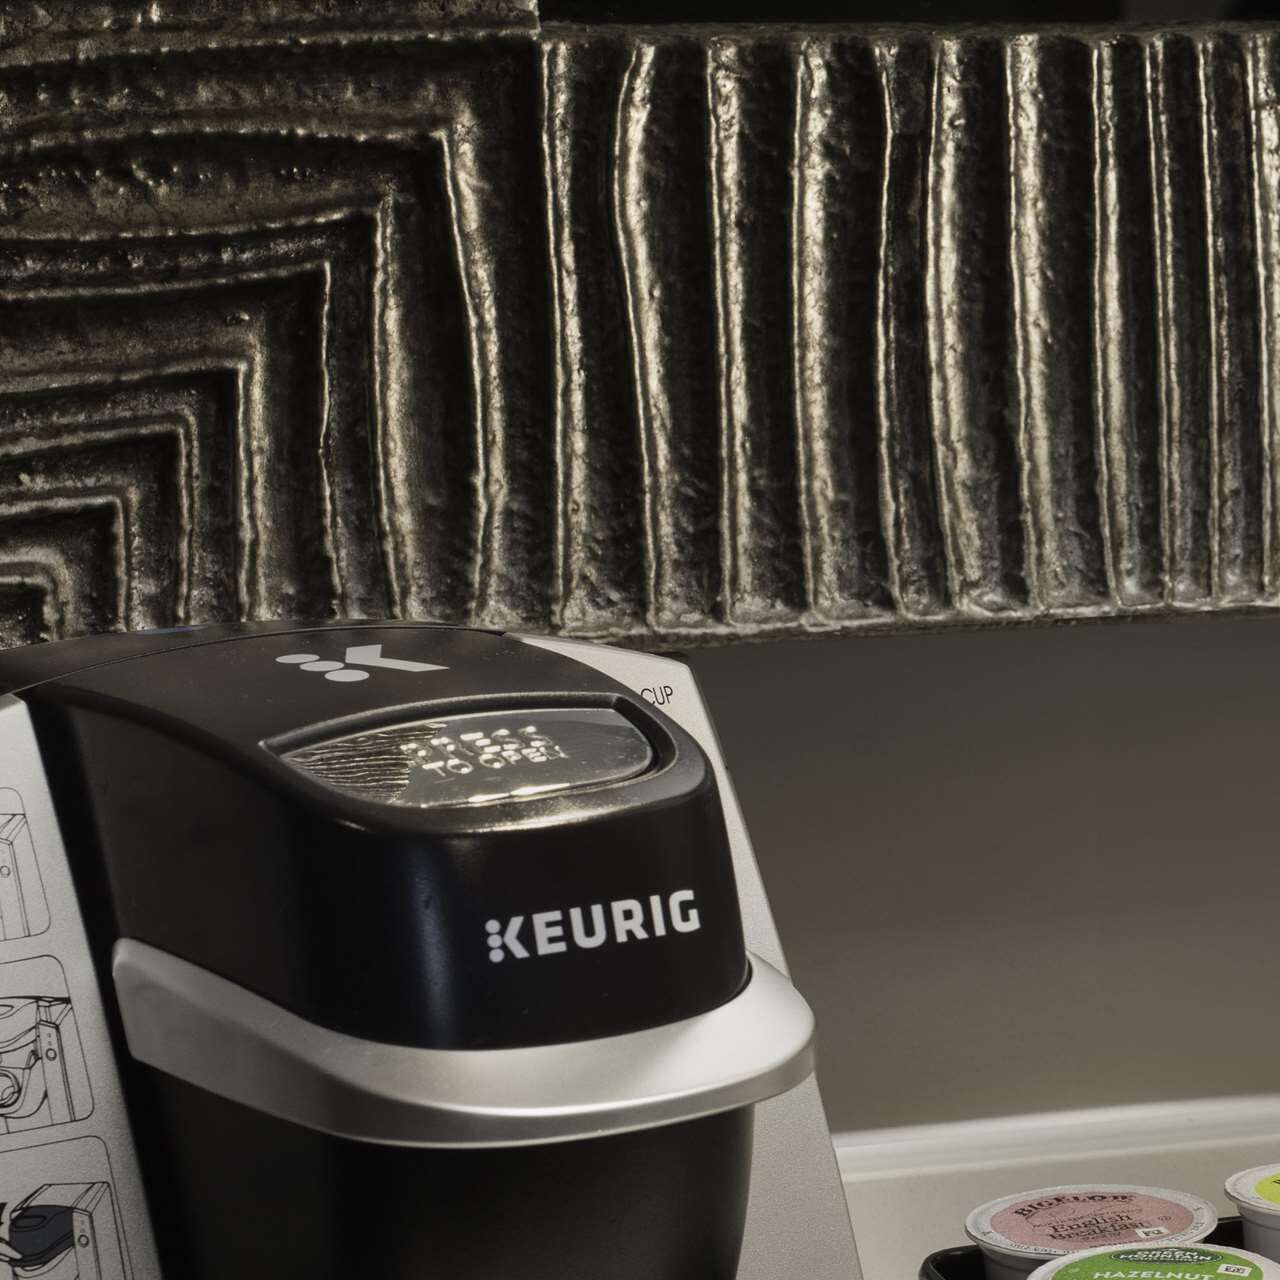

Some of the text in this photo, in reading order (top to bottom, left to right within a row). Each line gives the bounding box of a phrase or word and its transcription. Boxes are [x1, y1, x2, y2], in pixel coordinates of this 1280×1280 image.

[486, 889, 700, 963] KEURIG
[1051, 1213, 1132, 1233] English
[1093, 1271, 1216, 1280] HAZELNUT
